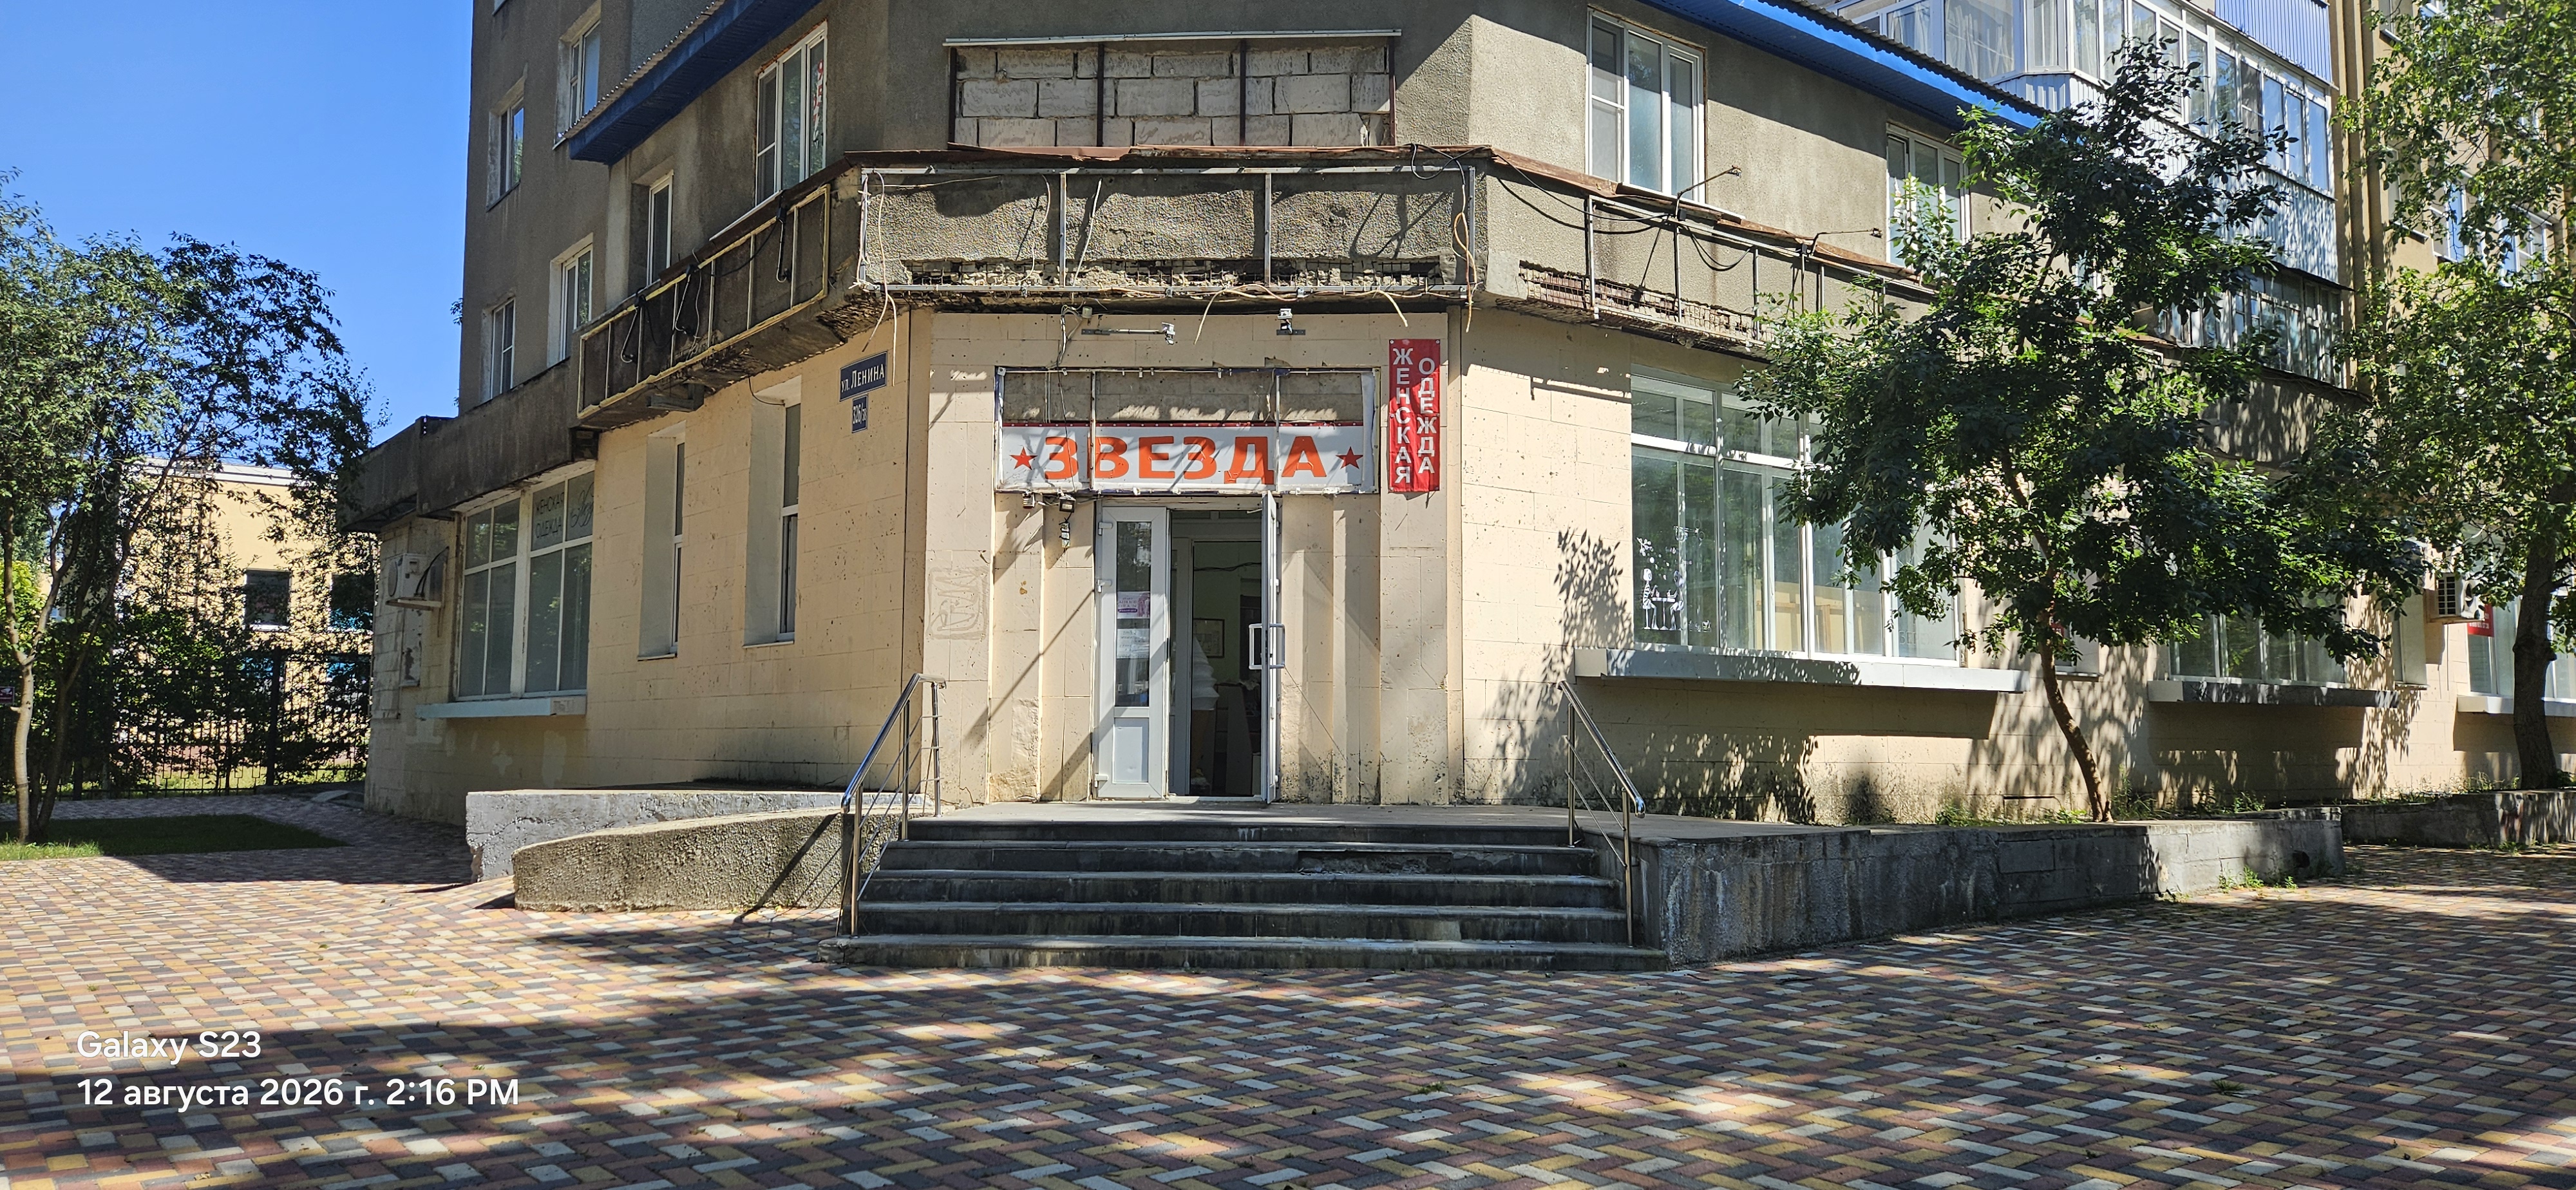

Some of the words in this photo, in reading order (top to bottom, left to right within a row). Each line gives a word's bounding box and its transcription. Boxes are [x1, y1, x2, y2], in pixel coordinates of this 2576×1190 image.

[1045, 436, 1327, 484] ЗВЕЗДА
[1392, 348, 1414, 484] ЖЕНСКАЯ
[1417, 357, 1437, 474] ОДЕЖДА
